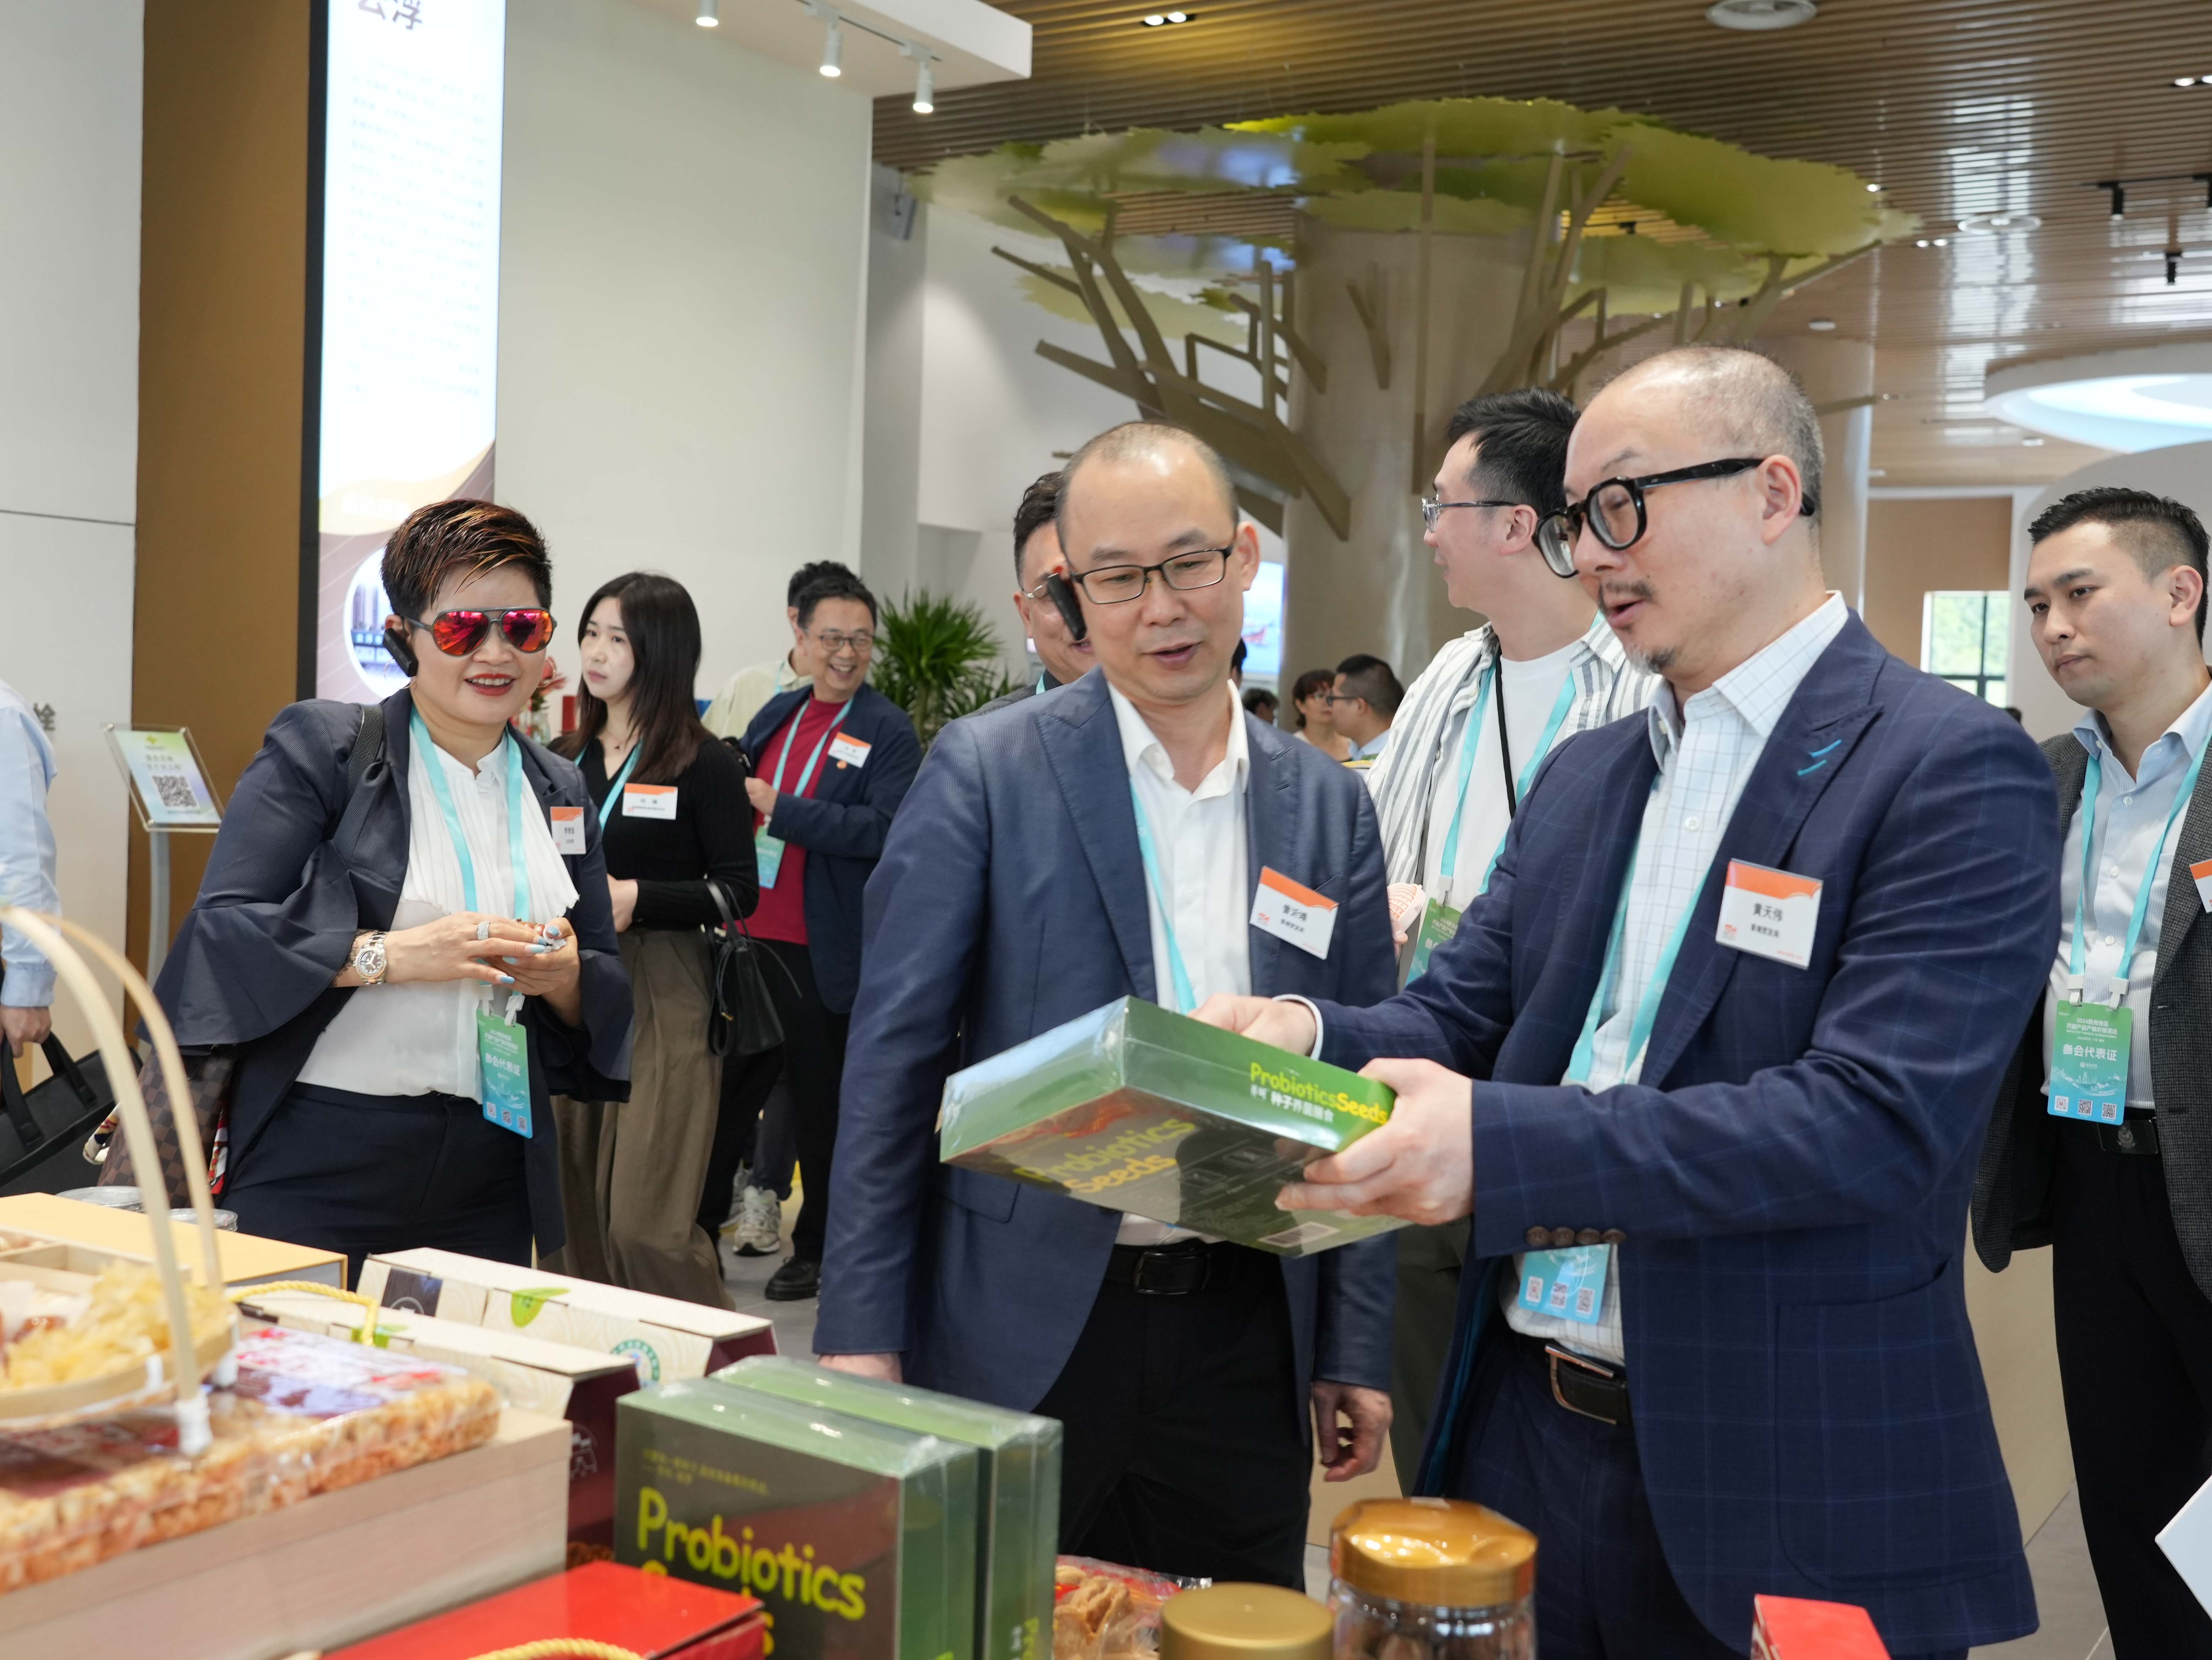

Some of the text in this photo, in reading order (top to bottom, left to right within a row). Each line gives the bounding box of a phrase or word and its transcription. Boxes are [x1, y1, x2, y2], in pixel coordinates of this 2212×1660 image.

[2063, 1044, 2117, 1061] 参会代表证
[1012, 1118, 1196, 1182] Probiotics
[1063, 1154, 1178, 1193] Seeds
[637, 1486, 866, 1621] Probiotics
